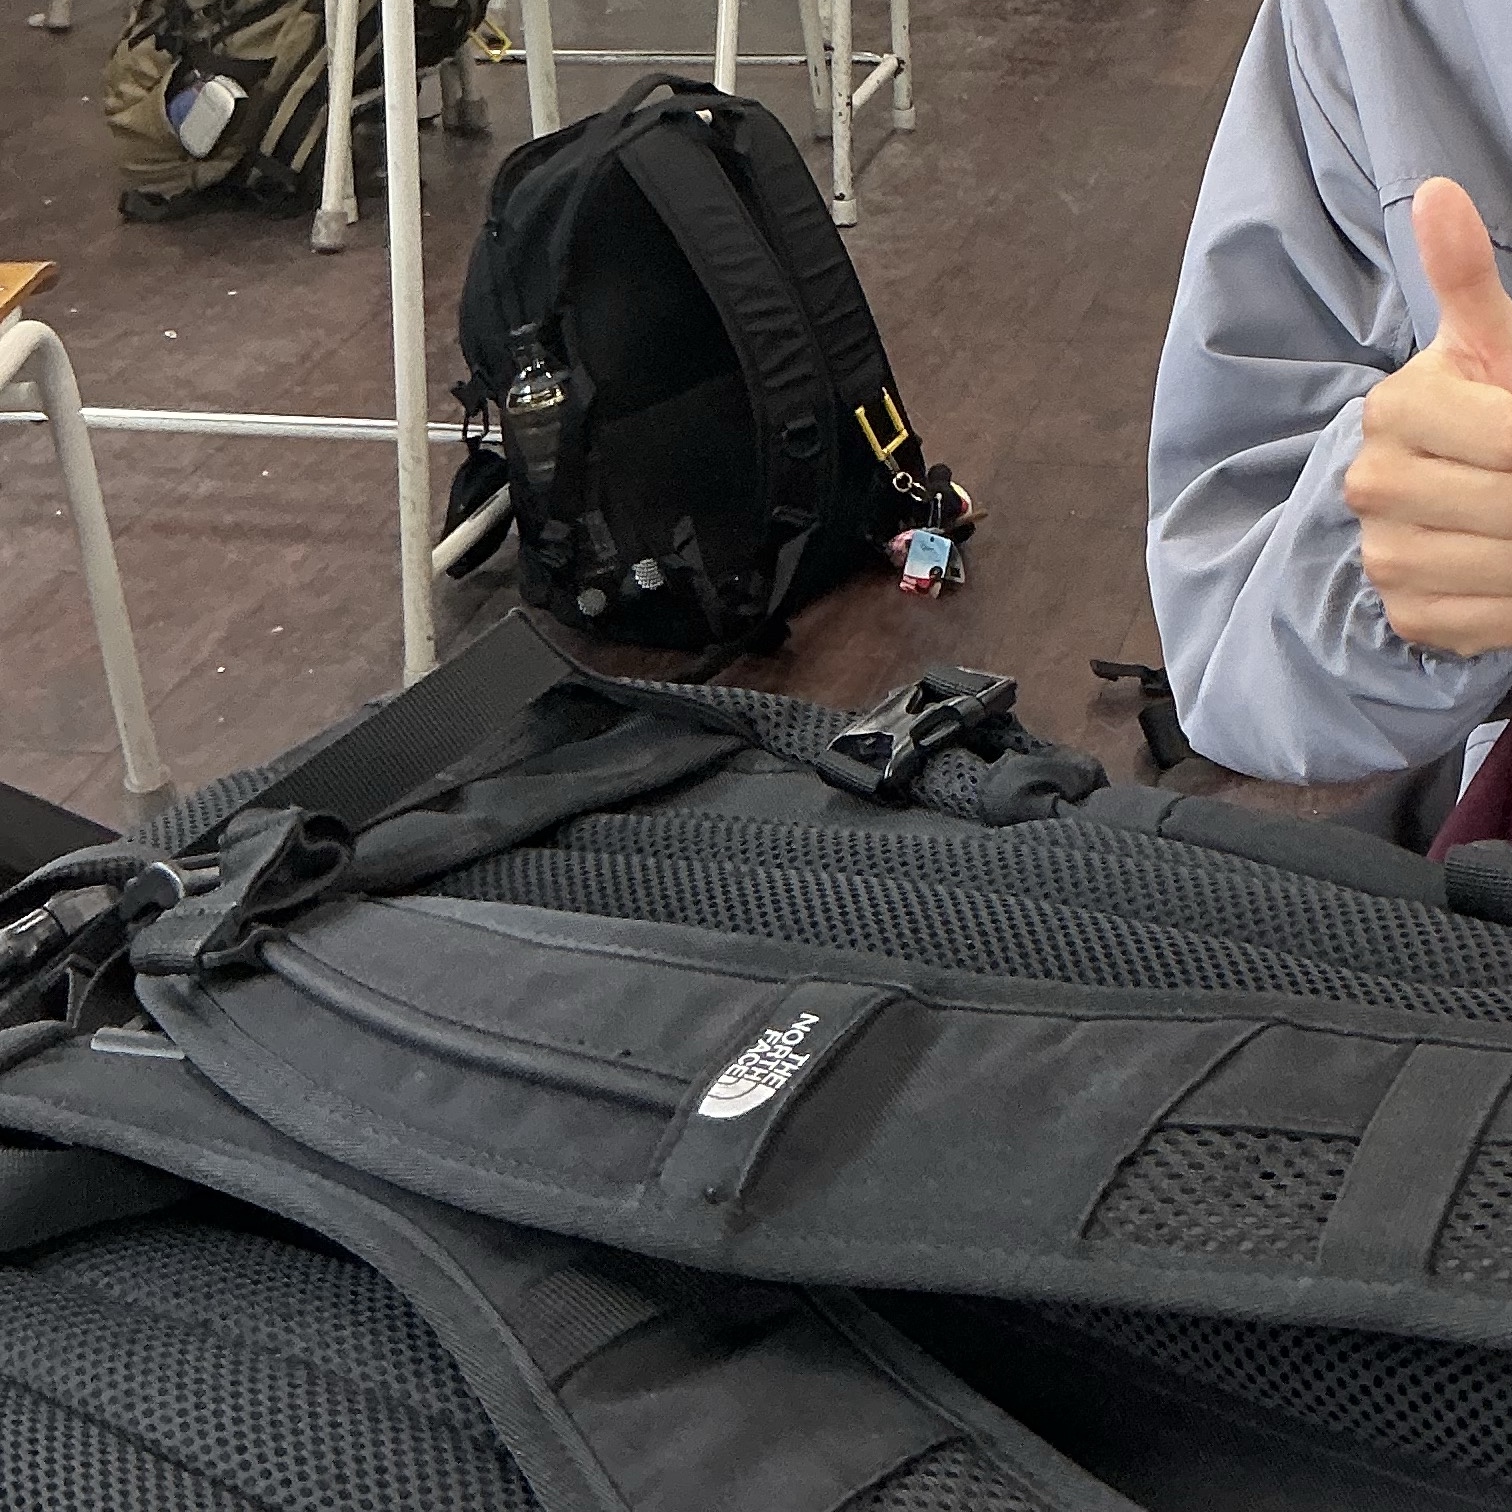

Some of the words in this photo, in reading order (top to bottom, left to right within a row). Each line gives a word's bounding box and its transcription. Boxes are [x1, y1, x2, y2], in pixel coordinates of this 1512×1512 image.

[725, 1028, 783, 1078] FACE
[744, 1012, 820, 1081] NORTH
[761, 1053, 811, 1089] THE
